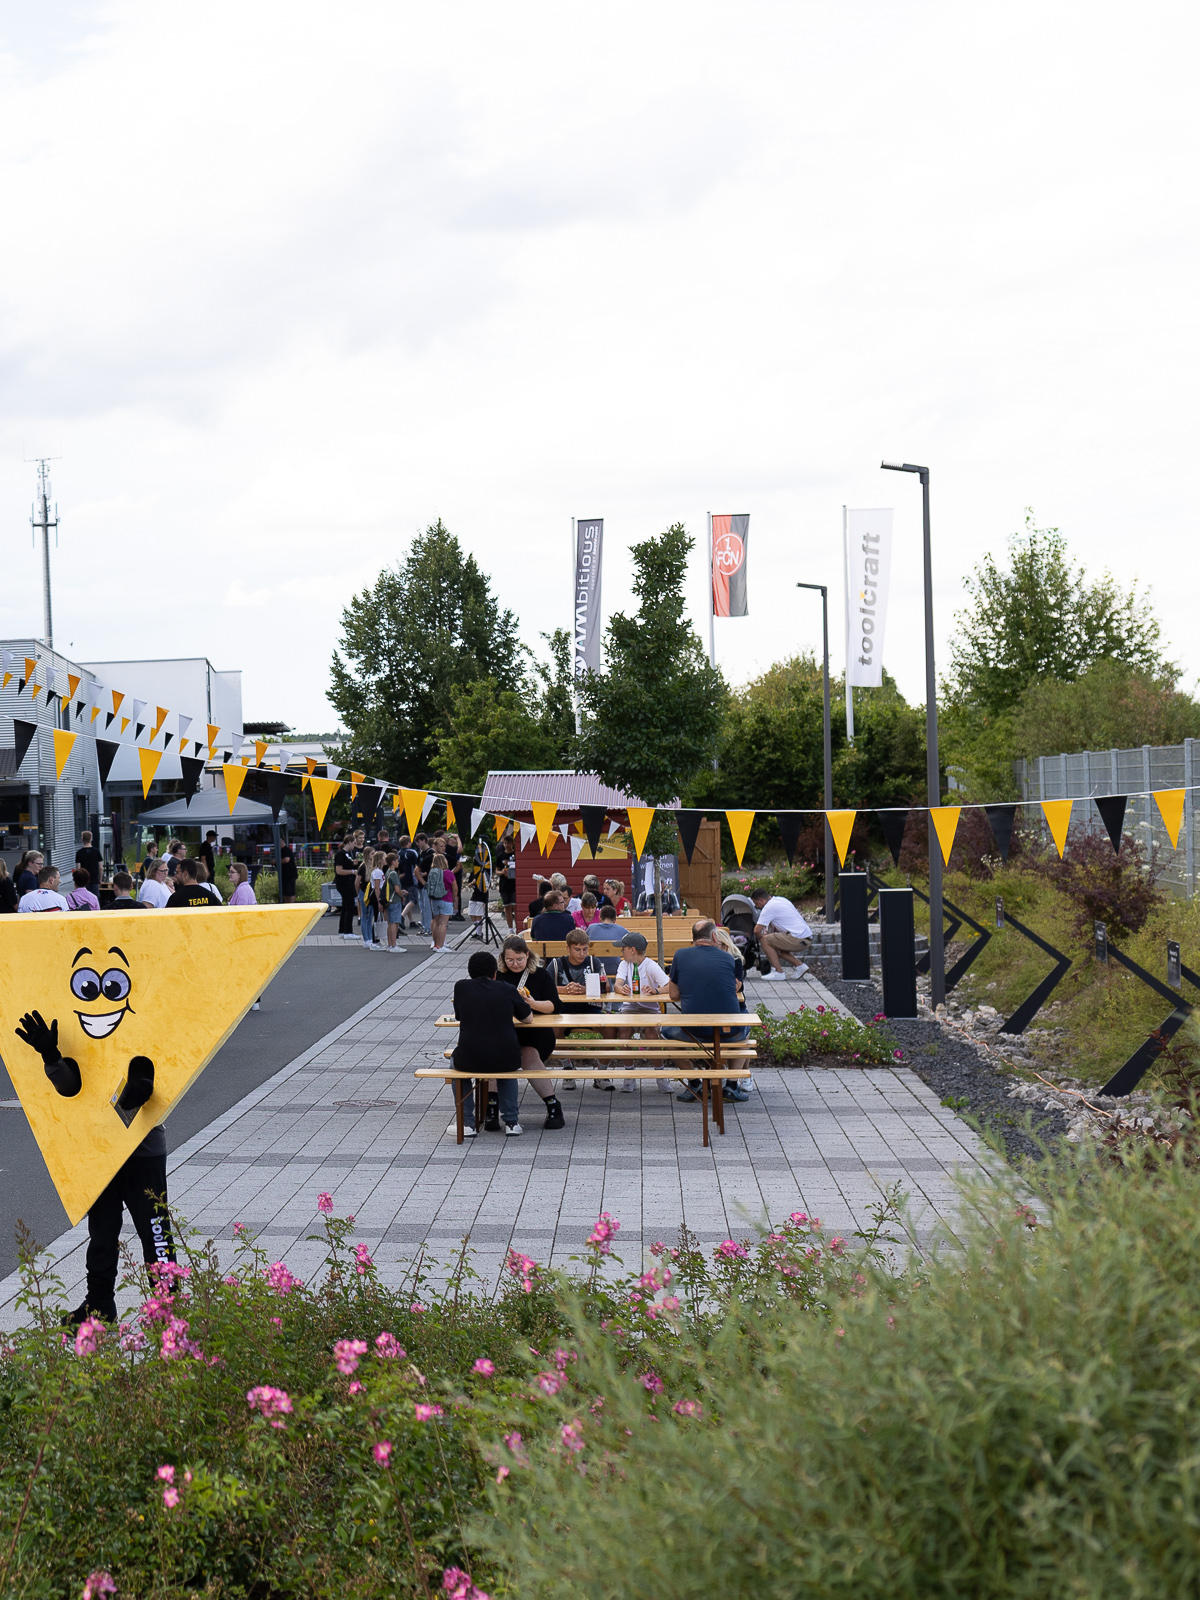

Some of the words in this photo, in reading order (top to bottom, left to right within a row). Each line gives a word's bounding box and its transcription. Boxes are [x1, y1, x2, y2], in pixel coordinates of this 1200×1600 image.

[716, 550, 740, 566] FCN
[858, 532, 880, 666] toolcraft
[188, 897, 209, 907] TEAM
[151, 1216, 171, 1281] toolcr
